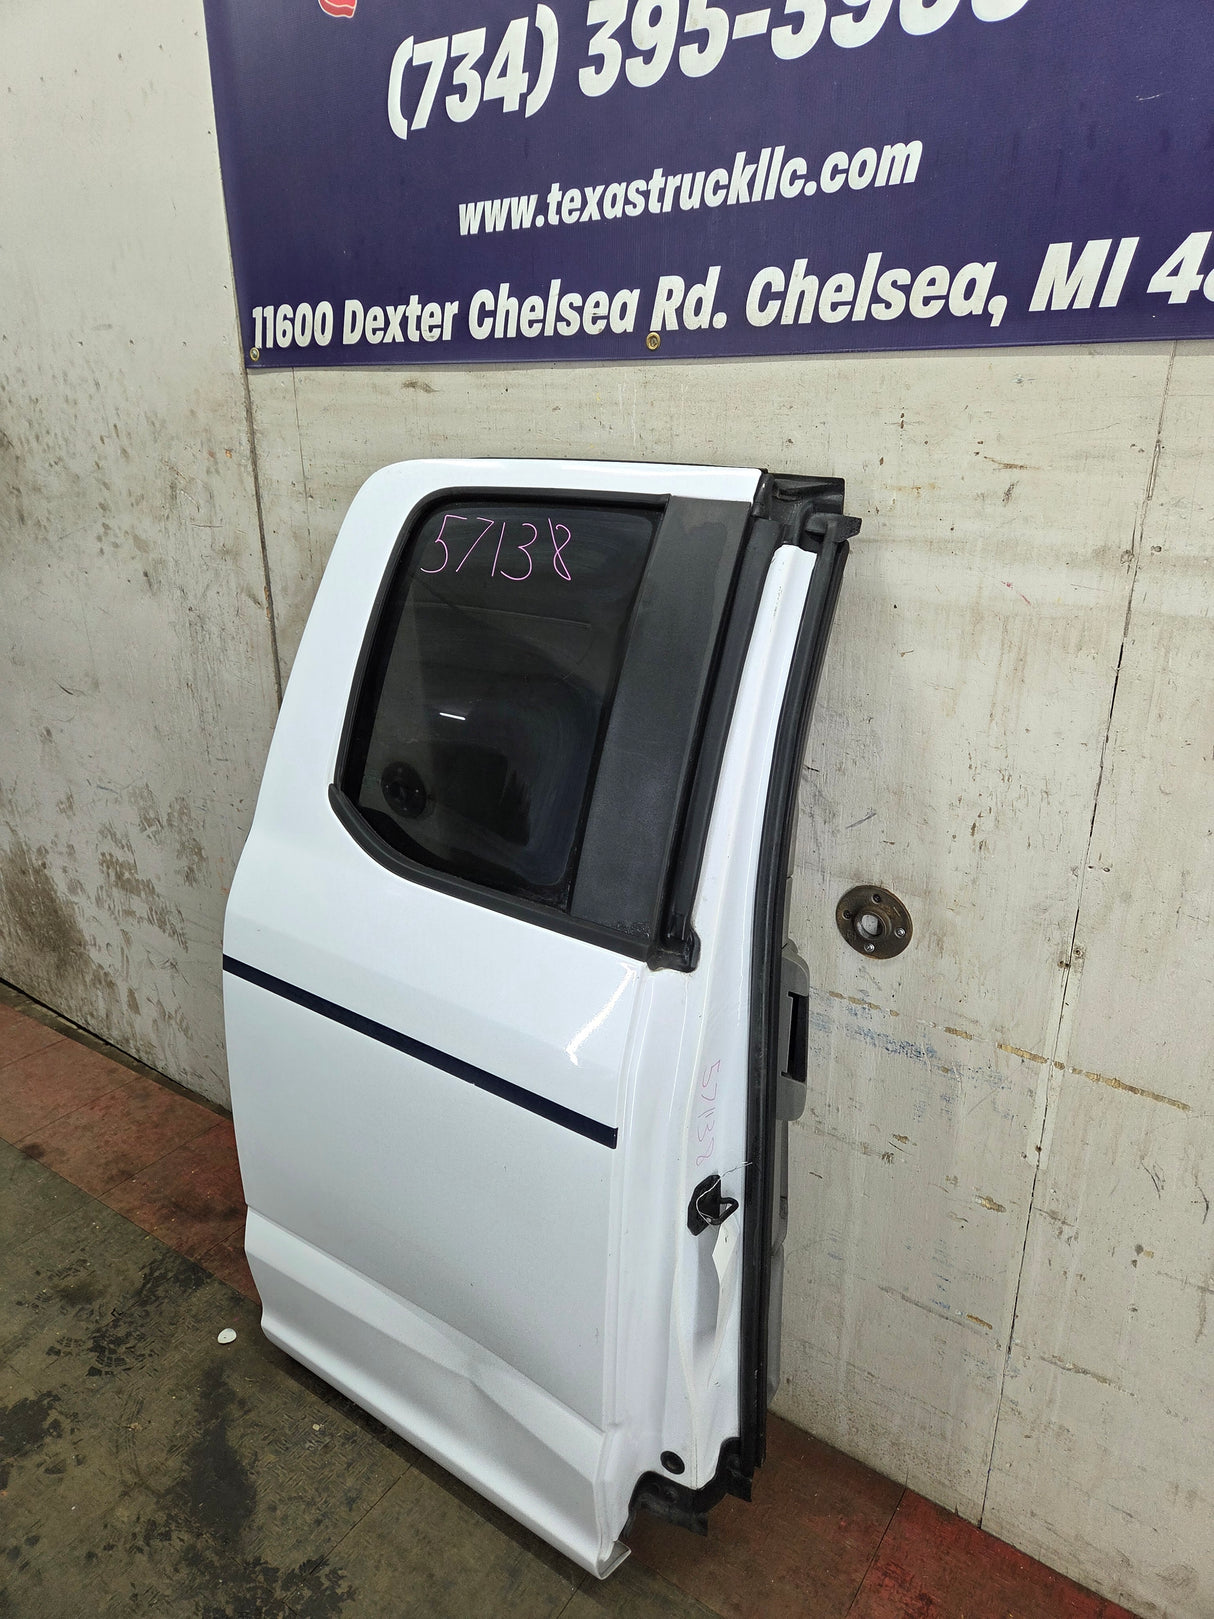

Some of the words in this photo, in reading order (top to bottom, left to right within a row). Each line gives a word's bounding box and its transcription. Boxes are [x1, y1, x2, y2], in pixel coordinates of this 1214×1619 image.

[387, 3, 559, 141] (734)
[578, 0, 1030, 98] 395-5
[458, 139, 923, 236] www.texastruckllc.com
[252, 300, 334, 351] 11600
[342, 294, 460, 346] Dexter
[468, 278, 641, 340] Chelsea
[649, 265, 728, 332] Rd.
[745, 251, 1008, 328] Chelsea,
[1028, 236, 1140, 312] MI
[1146, 230, 1214, 305] 4
[420, 514, 572, 581] 57138
